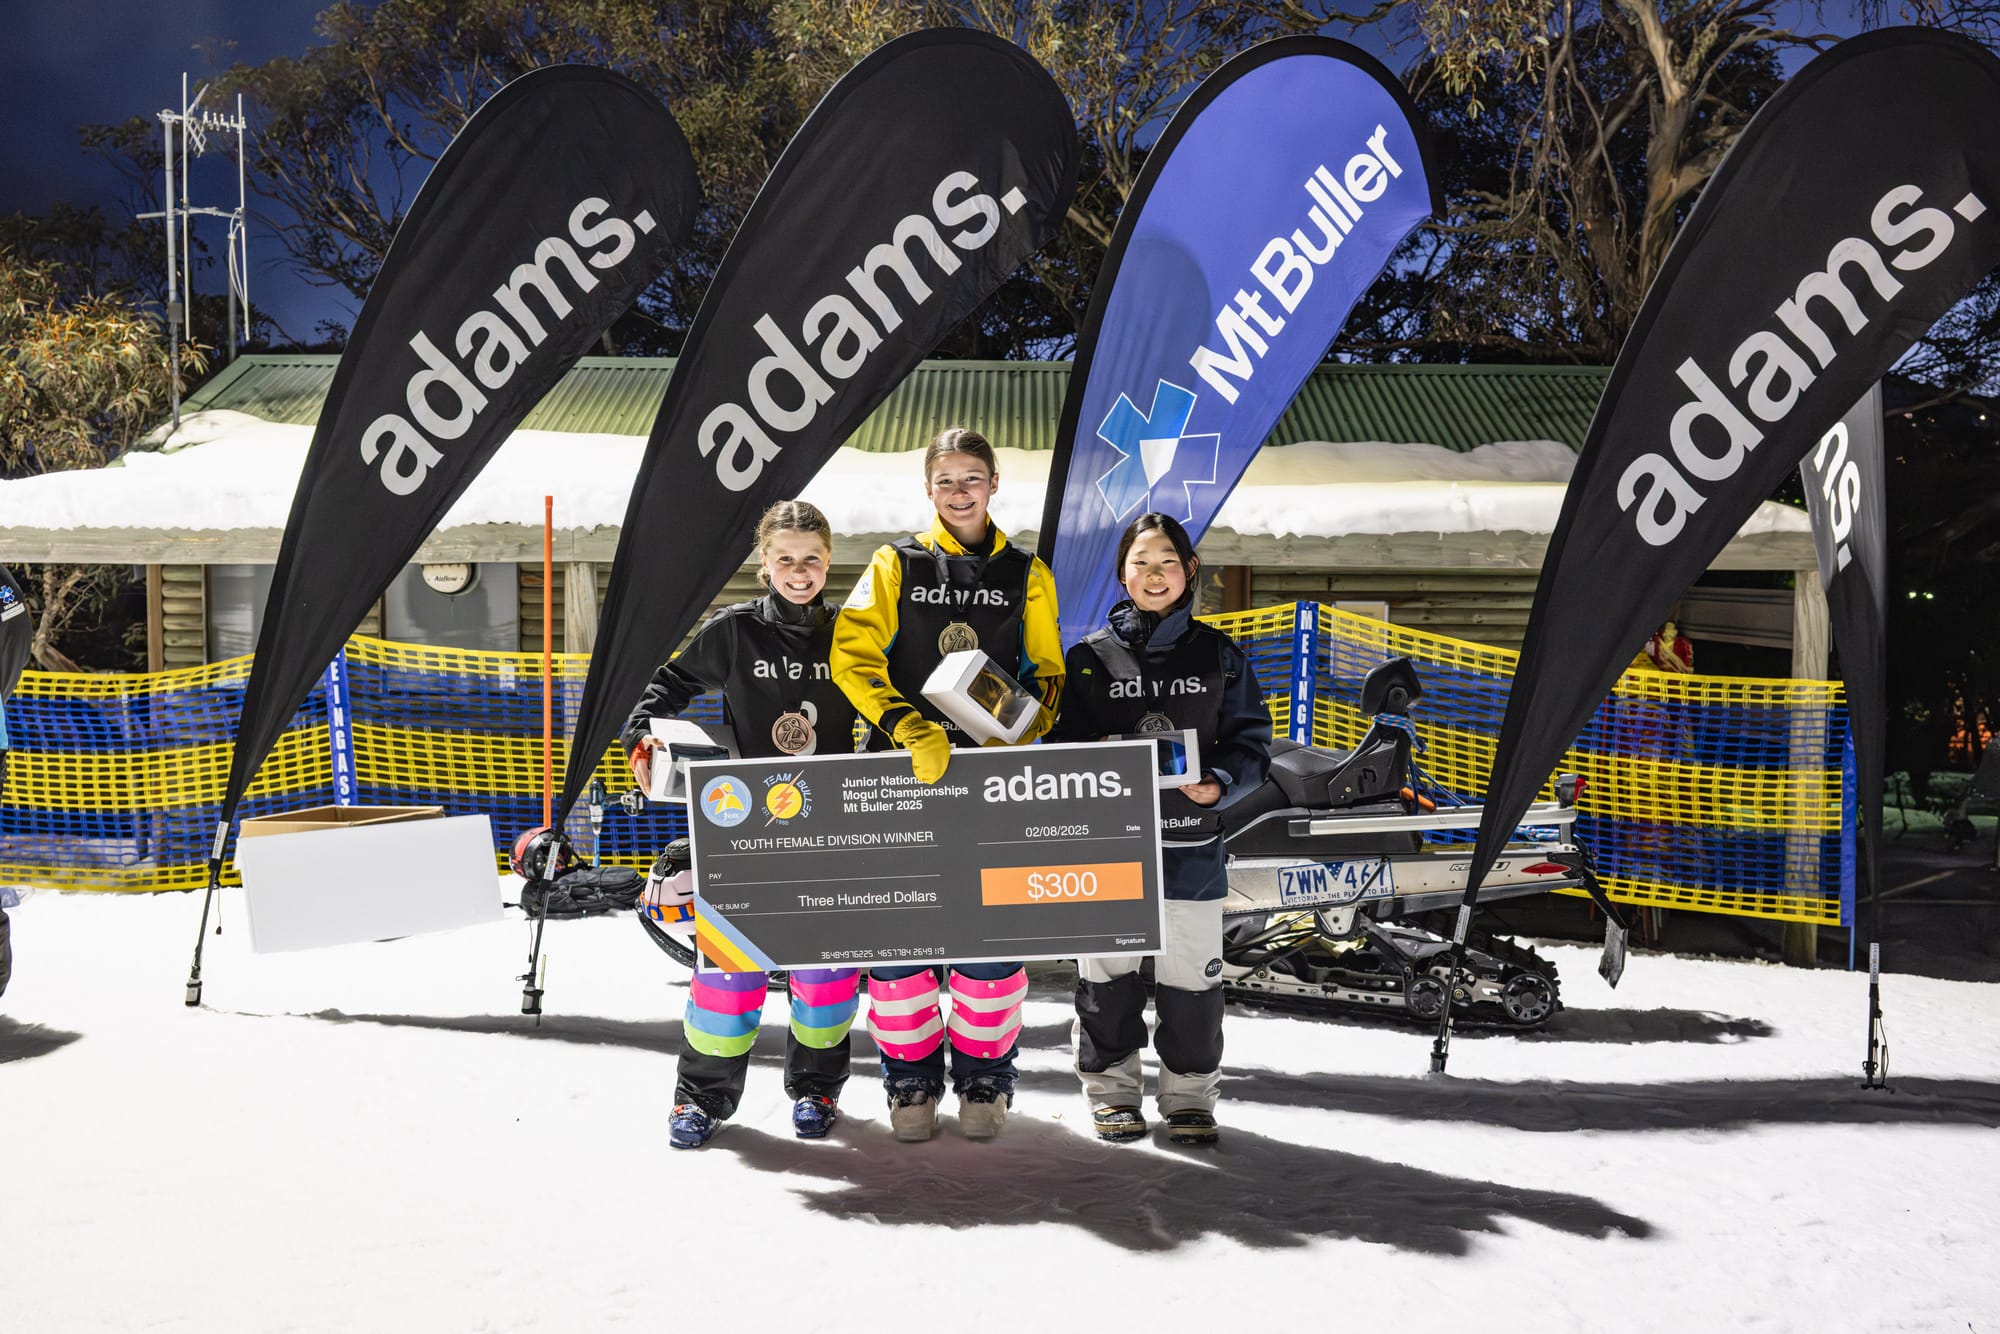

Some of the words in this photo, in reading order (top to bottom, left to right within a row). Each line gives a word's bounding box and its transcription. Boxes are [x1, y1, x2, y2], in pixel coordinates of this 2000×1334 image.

[698, 171, 1027, 492] adams.
[360, 197, 657, 496] adams.
[1617, 184, 1987, 546] adams.
[1296, 609, 1313, 745] MEINGA
[330, 653, 351, 806] EINGAS
[842, 777, 879, 788] Junior
[843, 789, 878, 802] Mogul
[880, 785, 969, 800] Championships
[983, 766, 1132, 802] adams.
[763, 773, 793, 787] TEAM
[796, 780, 813, 818] BULLER
[844, 802, 858, 813] Mt
[860, 801, 894, 812] Buller
[896, 800, 923, 811] 2025
[1025, 825, 1089, 837] 02/08/2025
[1126, 824, 1141, 832] Date
[731, 839, 773, 850] YOUTH
[776, 836, 825, 848] FEMALE
[827, 834, 881, 846] DIVISION
[883, 832, 934, 843] WINNER
[1027, 871, 1098, 901] $300
[1283, 868, 1327, 896] ZWM
[797, 895, 835, 907] Three
[837, 892, 891, 906] Hundred
[894, 890, 937, 903] Dollars
[1286, 895, 1318, 903] VICTORIA
[1115, 937, 1146, 945] Signature
